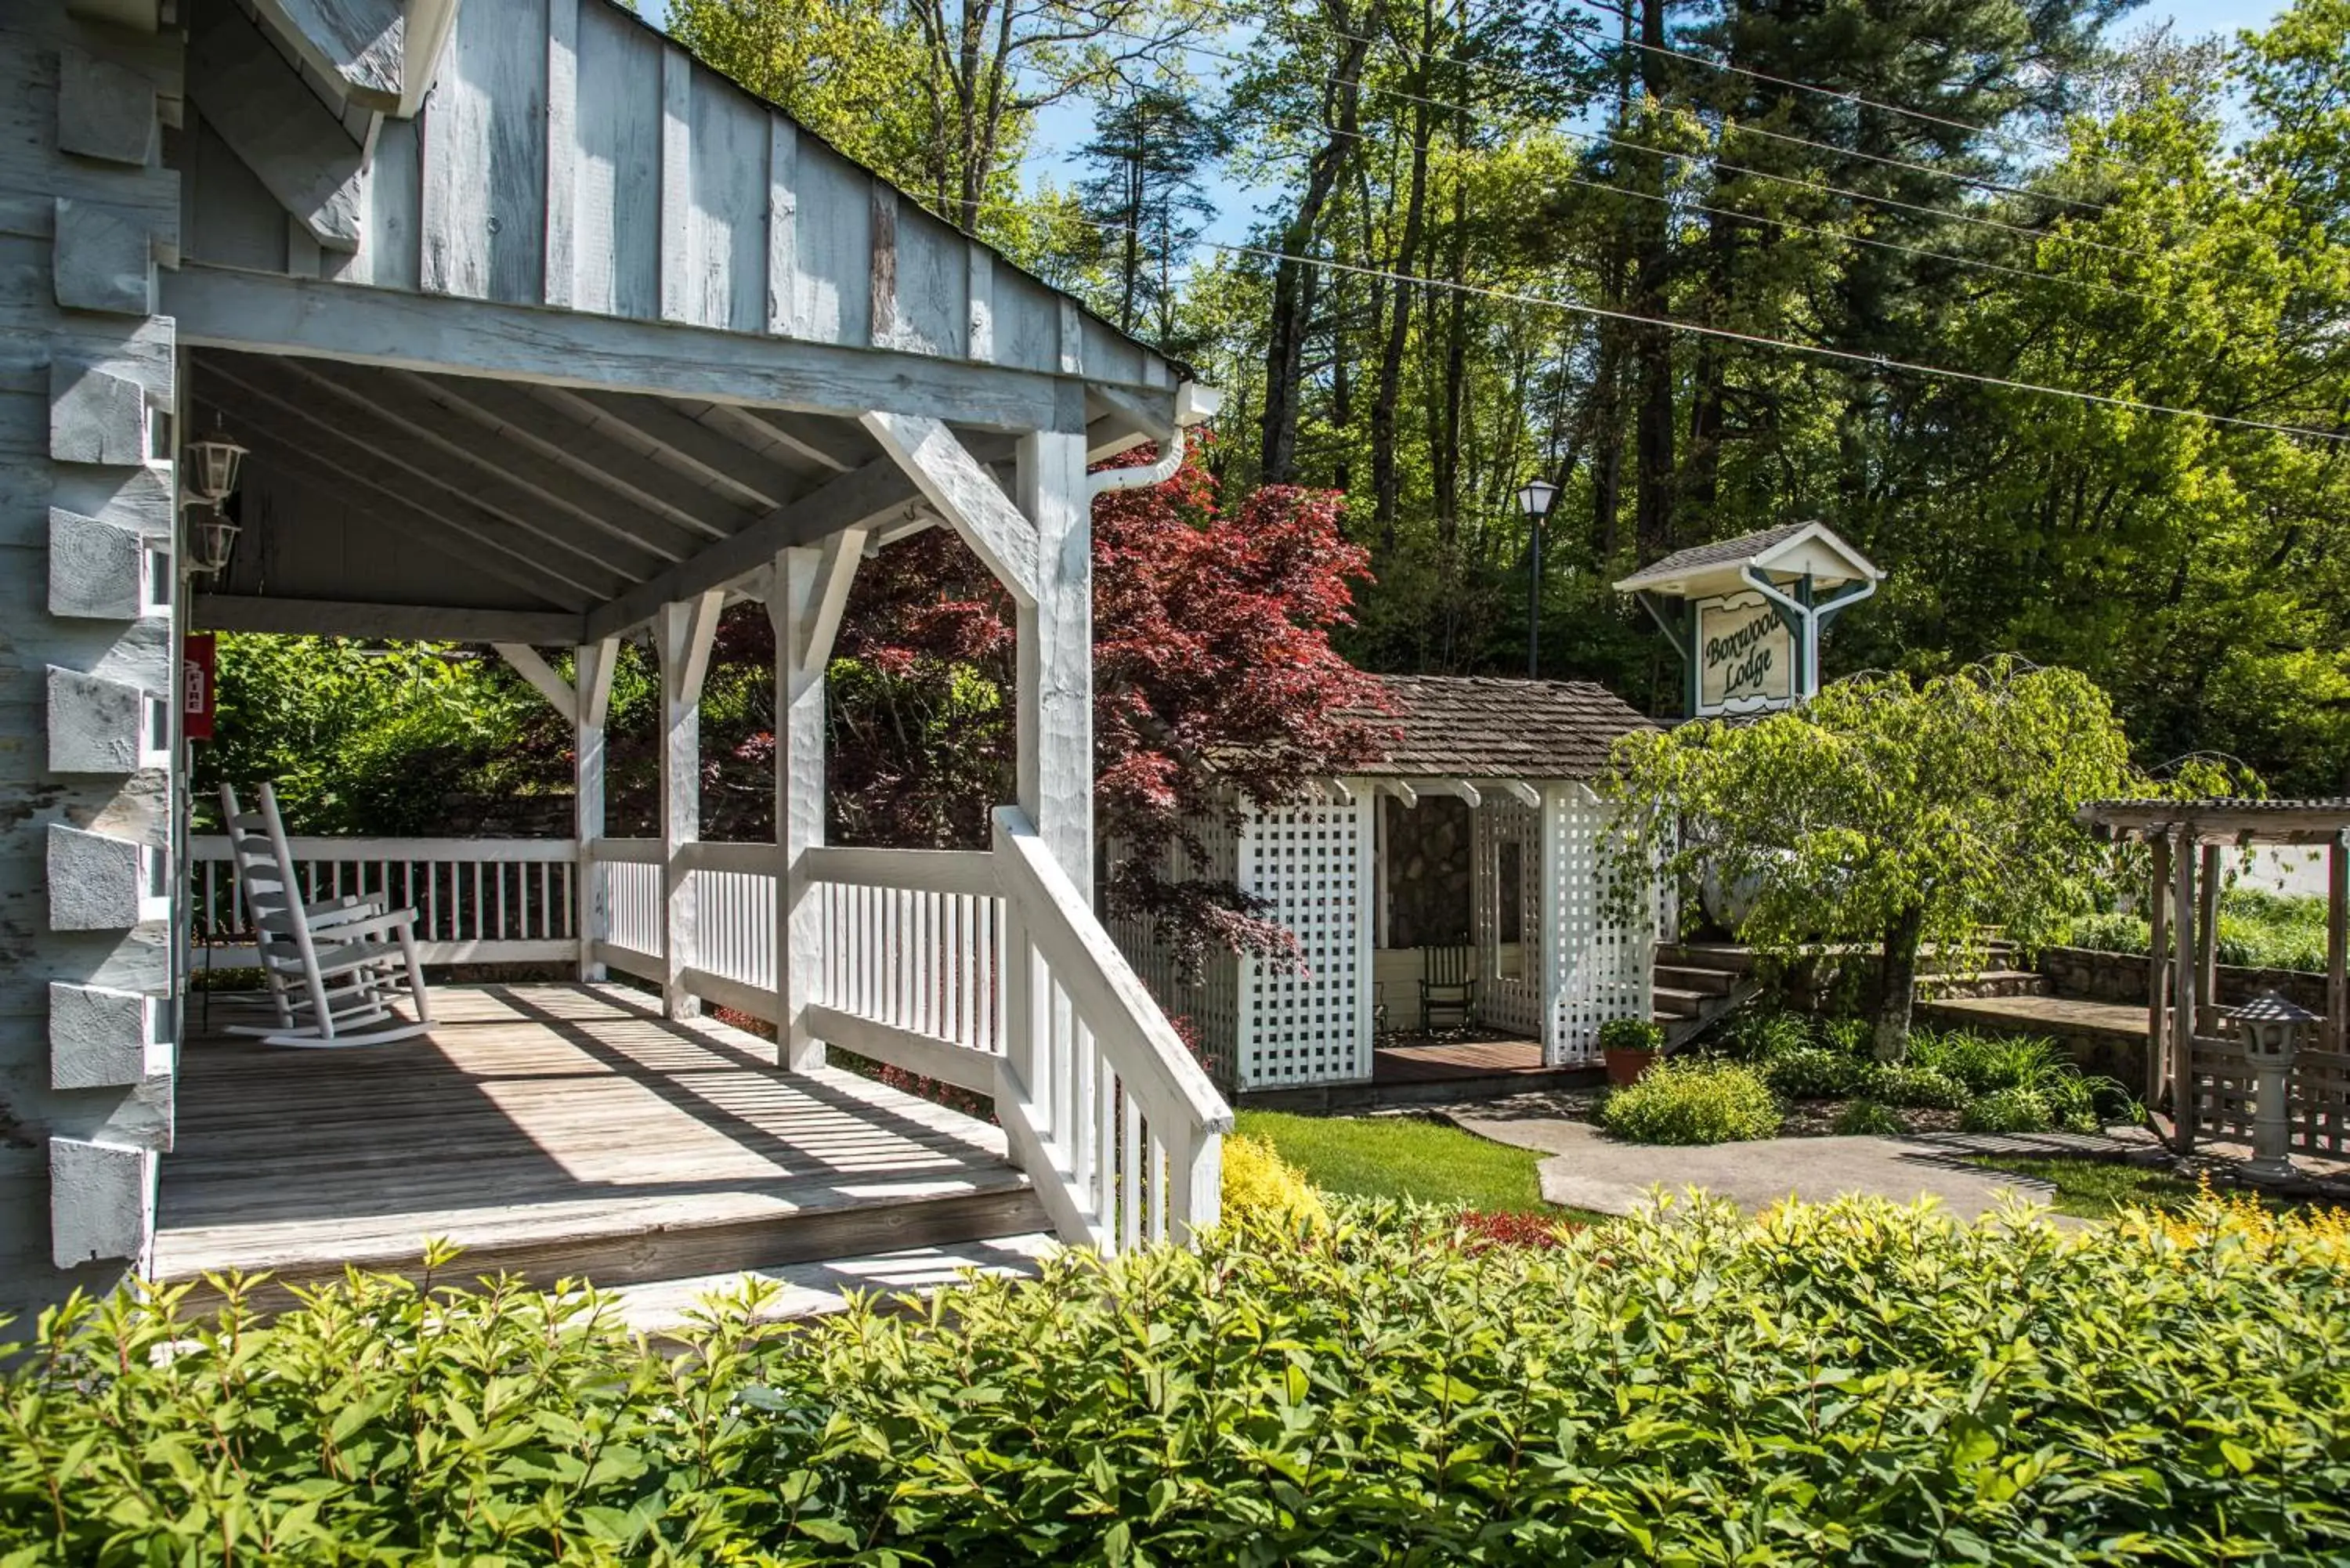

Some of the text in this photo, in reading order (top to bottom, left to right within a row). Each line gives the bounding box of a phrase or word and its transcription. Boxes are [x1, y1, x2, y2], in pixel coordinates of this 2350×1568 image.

[1706, 607, 1780, 669] Boxwood
[189, 673, 201, 710] FIRE
[1724, 644, 1773, 695] Lodge
